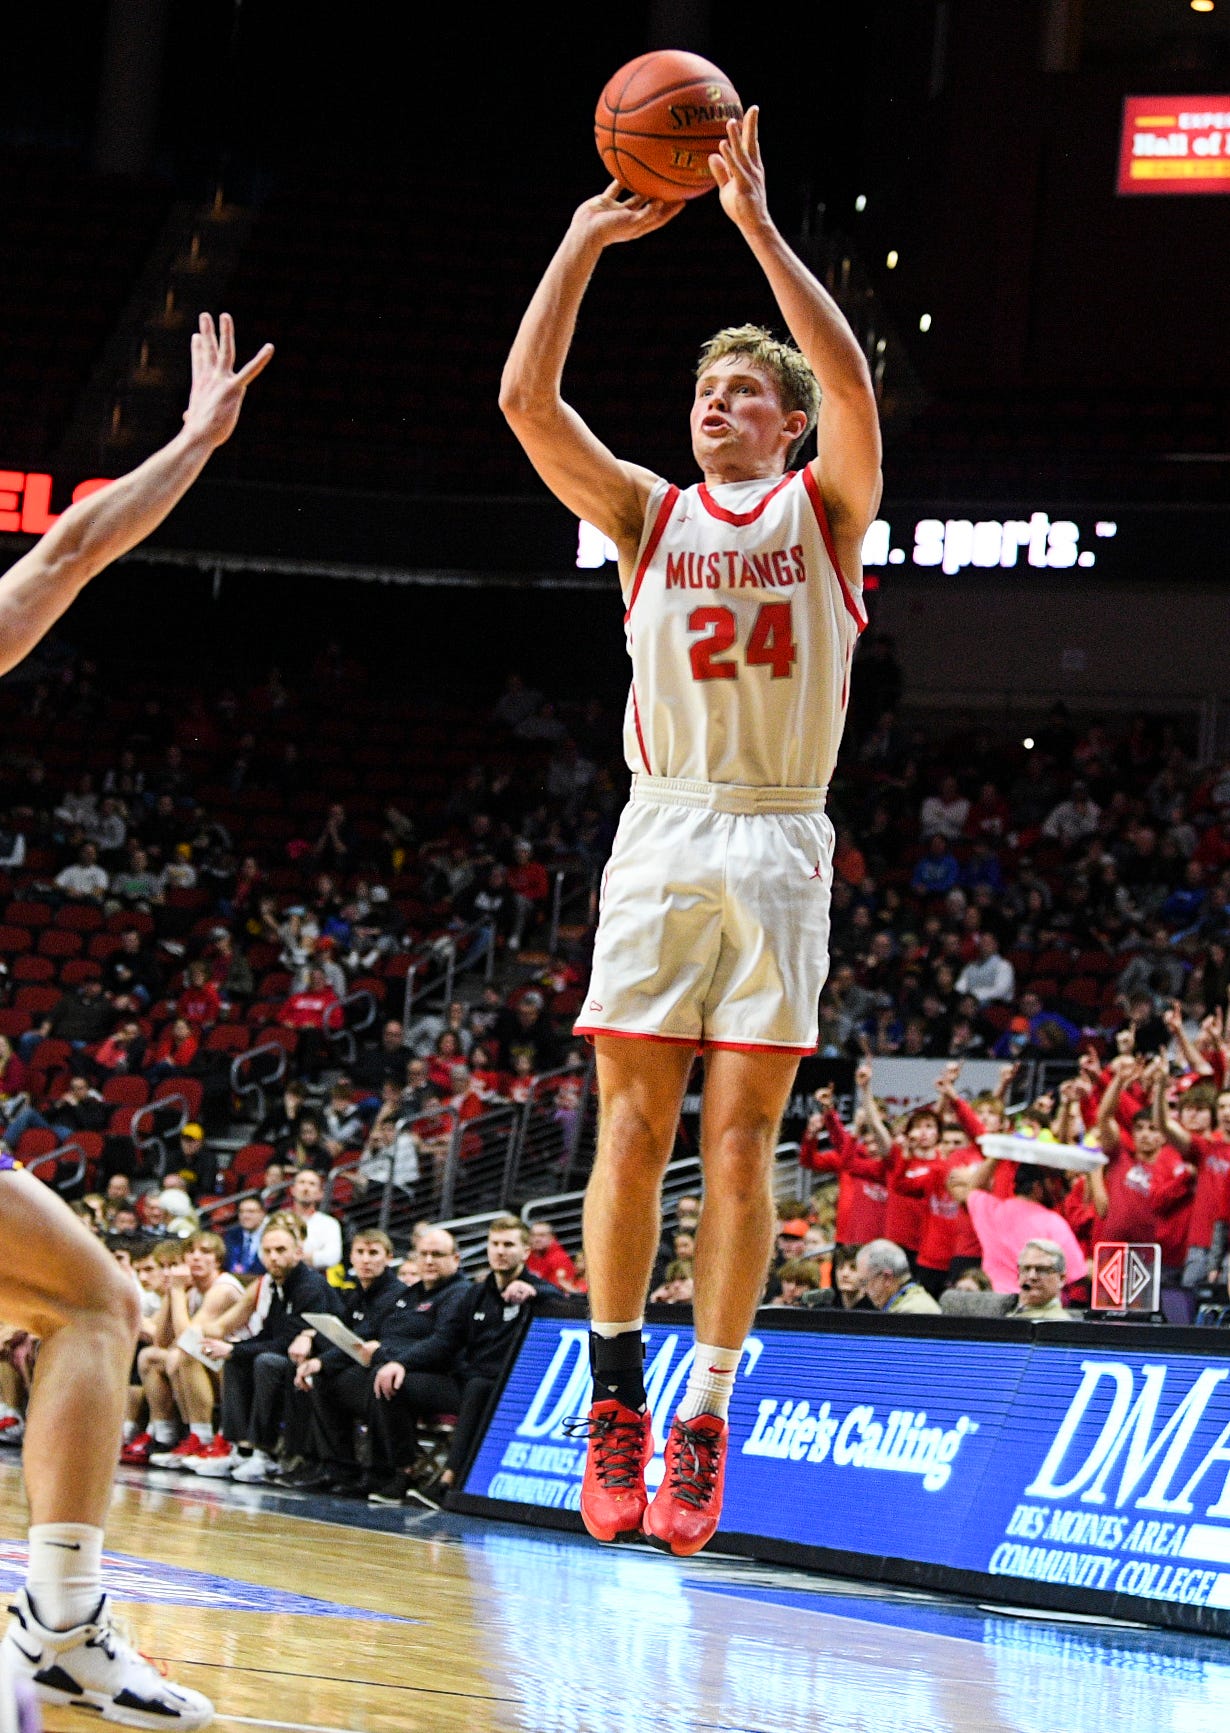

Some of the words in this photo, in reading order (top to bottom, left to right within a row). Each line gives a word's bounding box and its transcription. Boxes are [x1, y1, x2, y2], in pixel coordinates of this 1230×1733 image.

[1132, 132, 1188, 156] Hall
[1178, 112, 1230, 130] EXPE
[665, 544, 807, 590] MUSTANGS
[686, 600, 798, 682] 24
[742, 1399, 839, 1463] Life's
[833, 1405, 967, 1492] Calling
[1005, 1504, 1051, 1540] DES
[1042, 1509, 1130, 1551] MOINES
[1120, 1519, 1188, 1558] AREA
[988, 1542, 1121, 1590] COMMUNITY
[1115, 1560, 1218, 1606] COLLEGE
